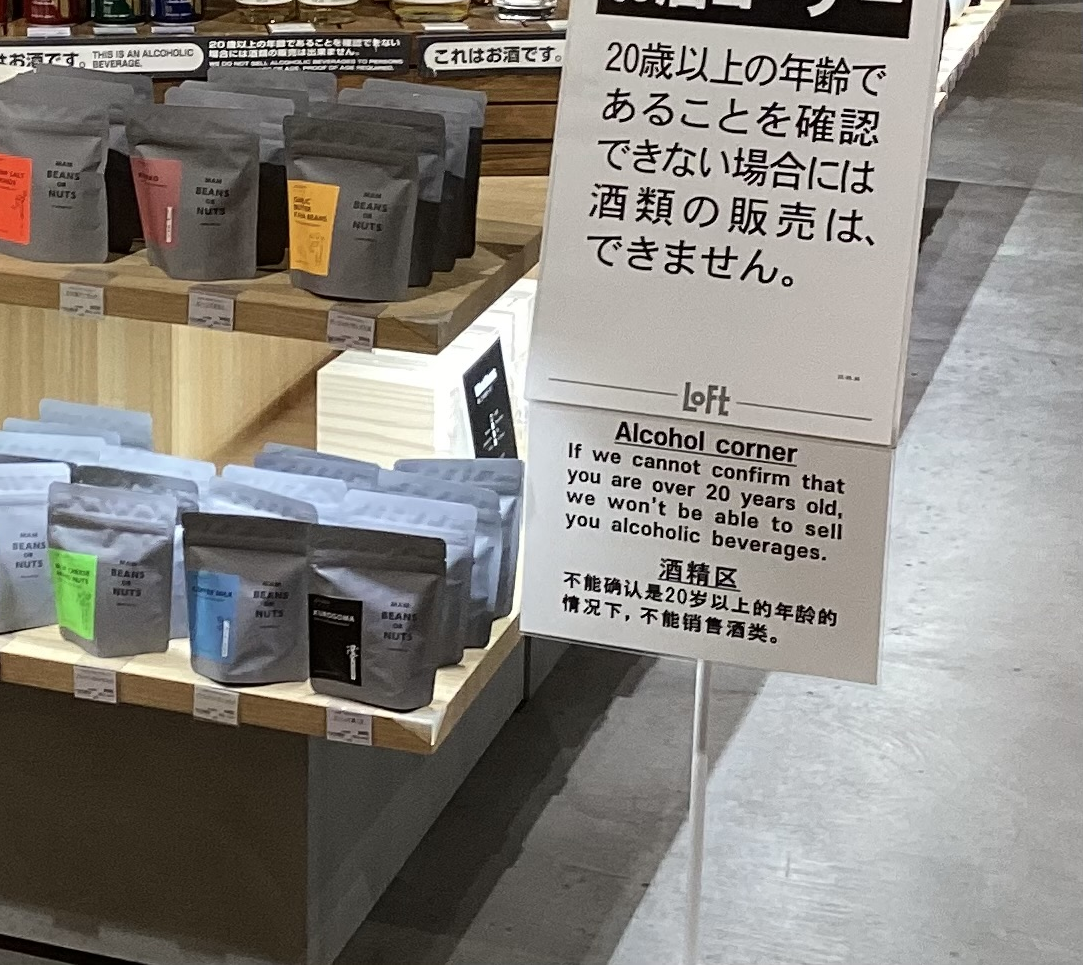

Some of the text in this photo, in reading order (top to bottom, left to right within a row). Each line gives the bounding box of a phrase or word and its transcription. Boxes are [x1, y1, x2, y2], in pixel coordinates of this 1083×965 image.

[92, 48, 194, 59] THIS IS AN ALCOHOLIC
[434, 46, 562, 64] これはお酒です。
[605, 42, 886, 97] 20歳以上の年齢で
[602, 87, 879, 146] あることを確認
[598, 138, 874, 194] できない場合には
[47, 170, 80, 180] BEANS
[48, 190, 76, 199] NUTS
[196, 187, 230, 197] BEANS
[197, 207, 225, 215] NUTS
[353, 200, 388, 212] BEANS
[589, 183, 876, 246] 酒類の販売は、
[353, 221, 382, 231] NUTS
[586, 234, 795, 288] できません。
[614, 421, 798, 463] Alcohol corner
[568, 443, 846, 495] If we cannot confirm that
[567, 468, 843, 518] you are over 20 years old,
[566, 492, 843, 540] we won't be able to sell
[565, 512, 828, 561] you alcoholic beverages.
[12, 542, 46, 550] BEANS
[15, 560, 43, 568] NUTS
[111, 569, 145, 579] BEANS
[659, 558, 738, 587] 酒精区
[113, 588, 142, 597] NUTS
[253, 591, 289, 600] BEANS
[563, 571, 837, 627] 不能确认是20岁以上的年龄的
[255, 609, 284, 618] NUTS
[381, 611, 417, 621] BEANS
[383, 631, 413, 641] NUTS
